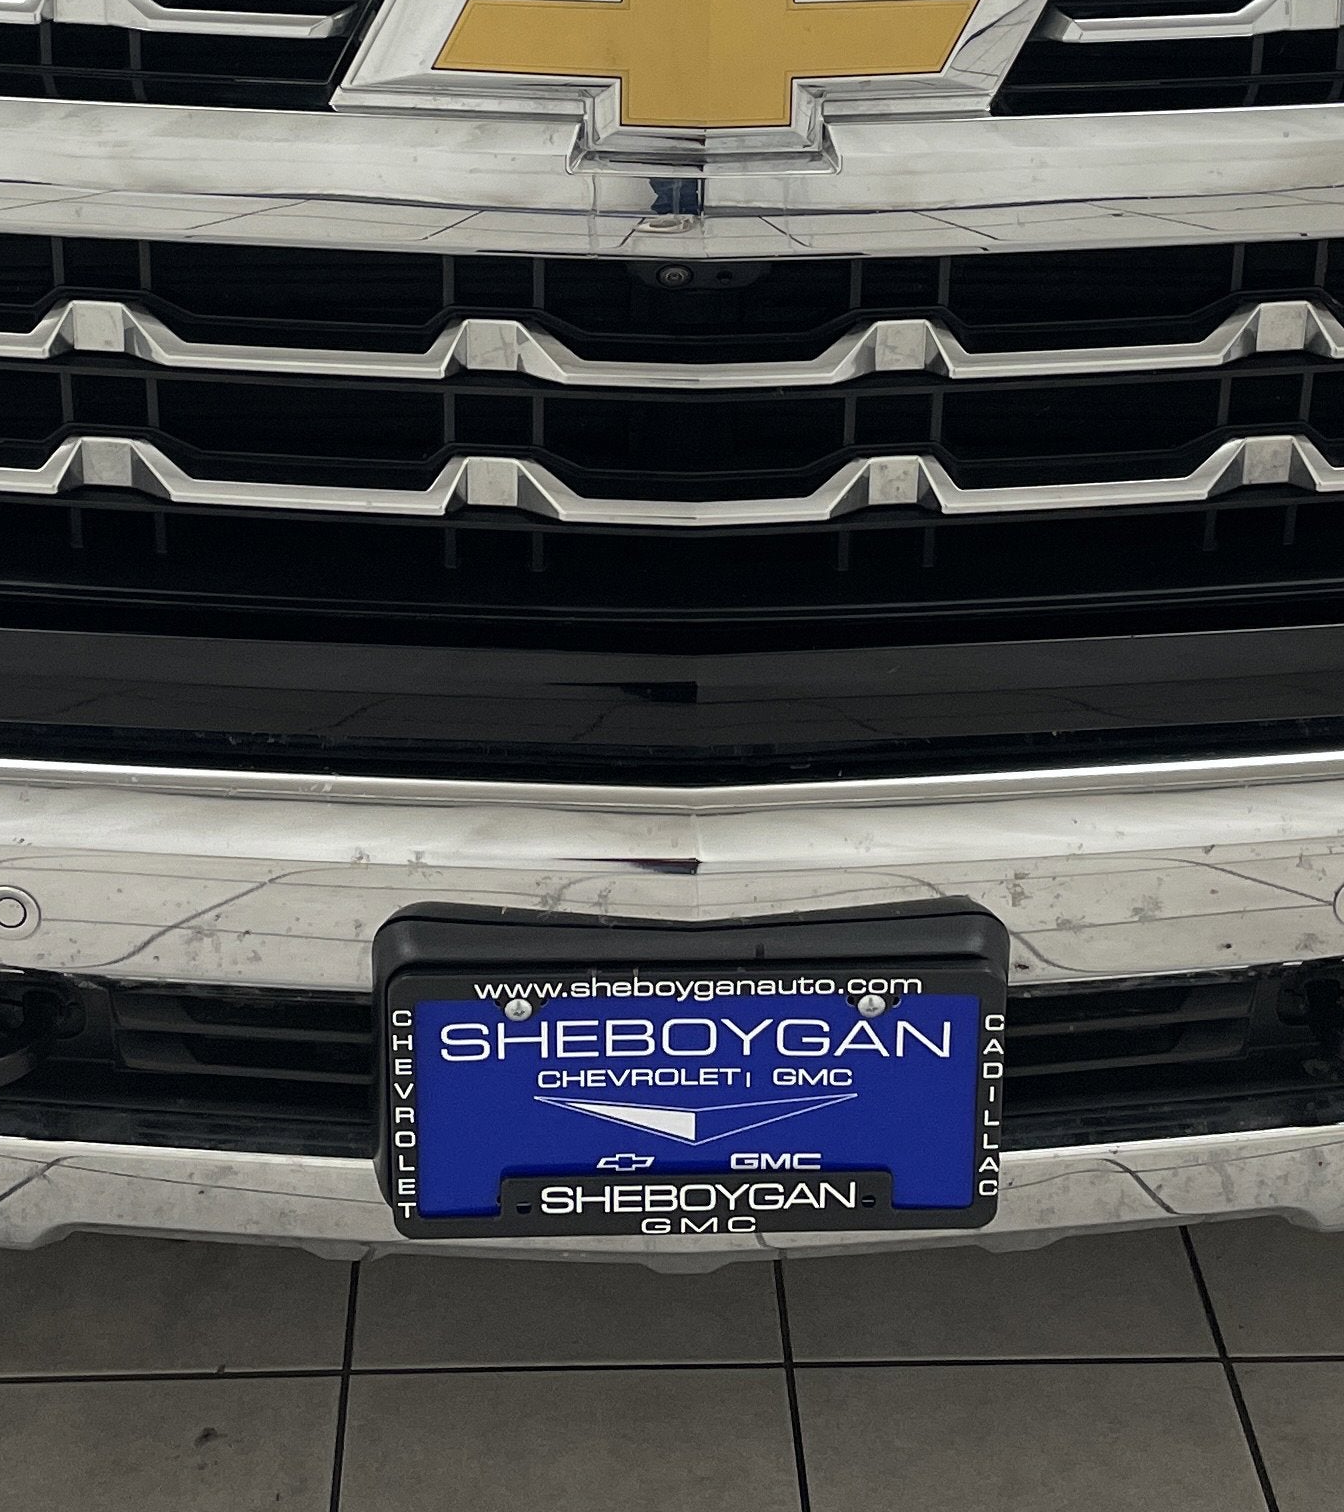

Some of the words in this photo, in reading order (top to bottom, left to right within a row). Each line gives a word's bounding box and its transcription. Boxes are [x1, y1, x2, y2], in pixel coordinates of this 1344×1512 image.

[474, 976, 923, 1002] www.sheboyganauto.com
[440, 1017, 951, 1062] SHEBOYGAN
[537, 1067, 742, 1088] CHEVROLET
[772, 1067, 853, 1087] GMC
[391, 1009, 417, 1220] CHEVROLET
[978, 1014, 1005, 1197] CADILLAC
[730, 1152, 822, 1171] GMC
[540, 1181, 857, 1214] SHEBOYGAN
[641, 1215, 757, 1234] GMC
